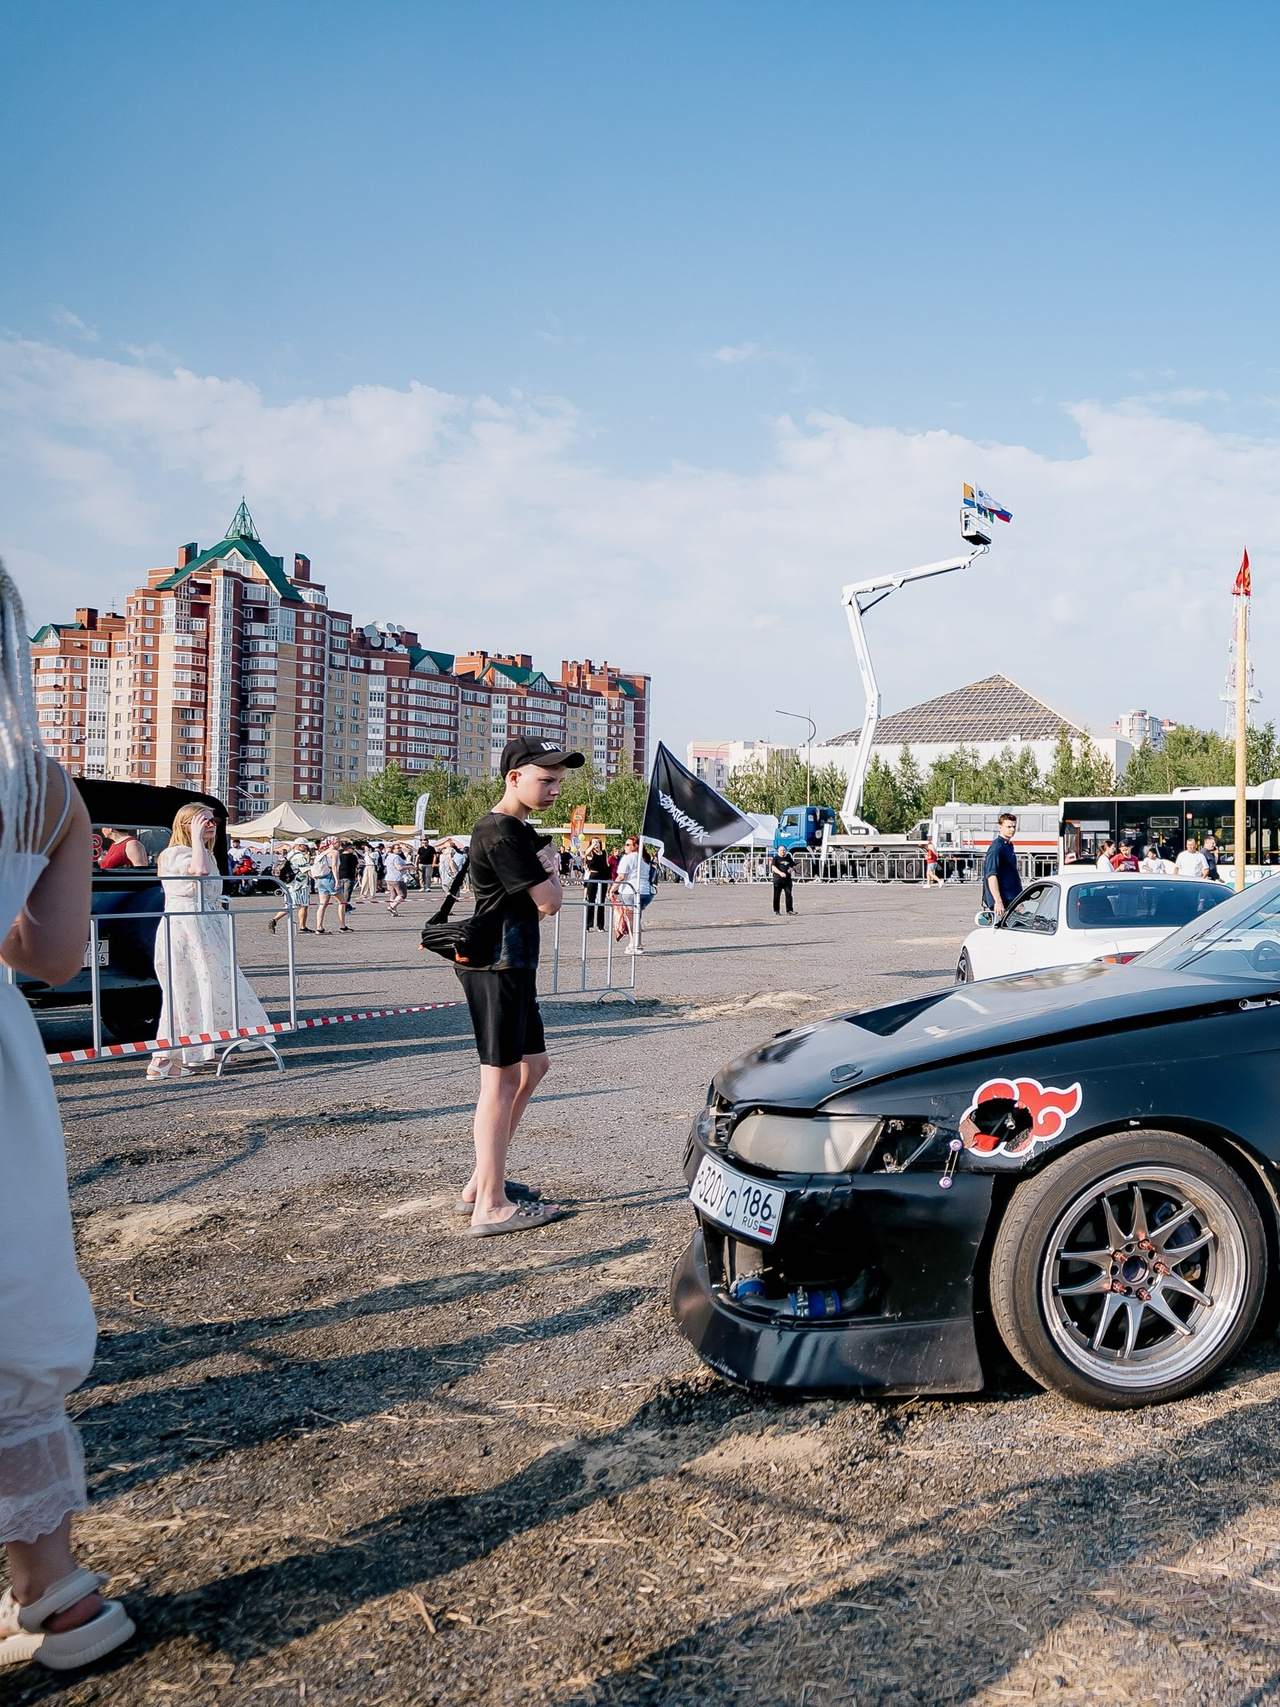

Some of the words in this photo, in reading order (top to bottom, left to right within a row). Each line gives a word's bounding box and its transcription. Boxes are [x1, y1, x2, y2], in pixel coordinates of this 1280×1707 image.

[1229, 869, 1274, 879] СРГУТ
[742, 1186, 772, 1221] 186
[741, 1217, 759, 1231] RUS
